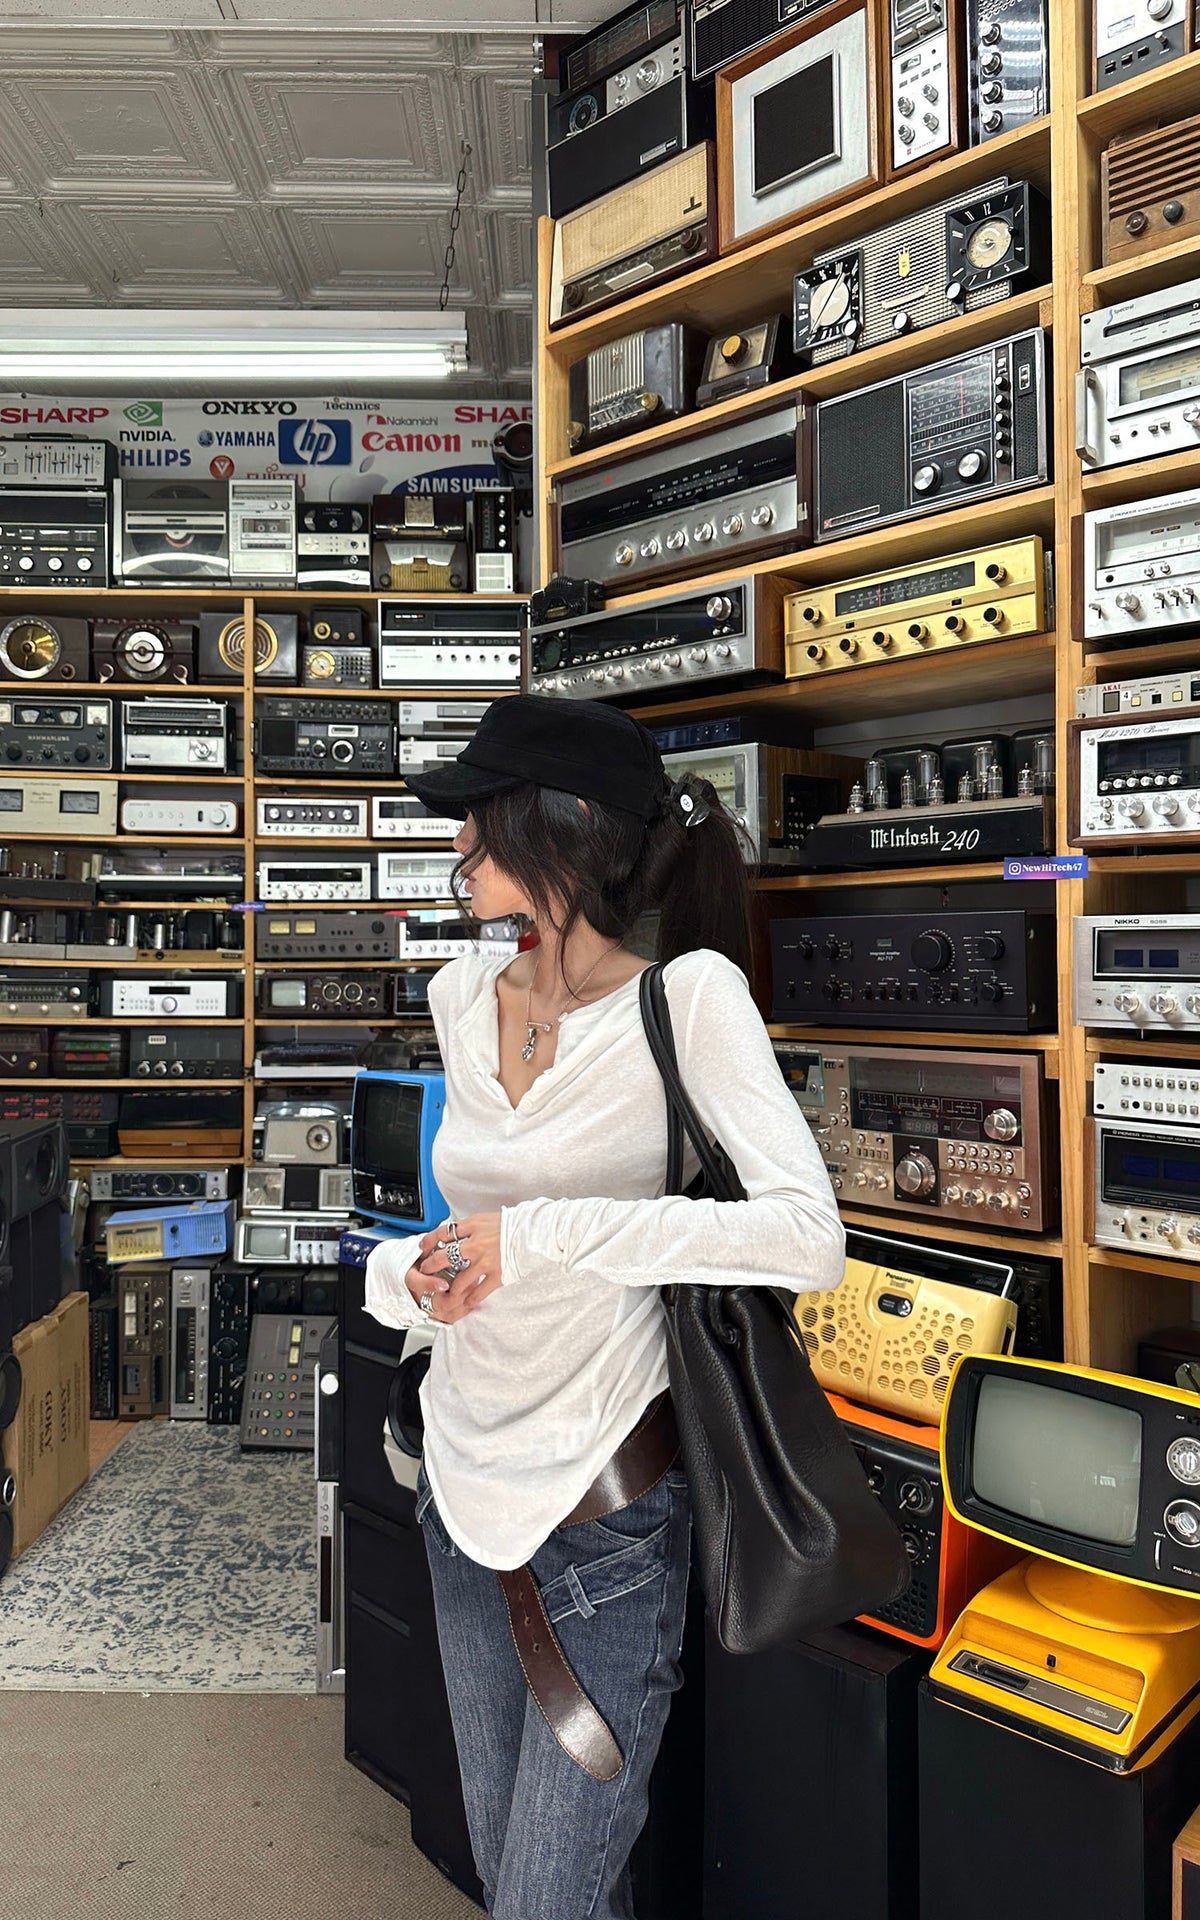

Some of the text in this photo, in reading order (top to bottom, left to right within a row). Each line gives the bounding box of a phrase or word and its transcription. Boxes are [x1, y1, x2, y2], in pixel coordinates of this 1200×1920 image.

[1113, 303, 1136, 315] Spectral
[202, 401, 298, 415] ONKYO
[323, 401, 381, 411] Technics
[0, 407, 109, 424] SHARP
[387, 416, 439, 426] Nakamichi
[455, 406, 532, 423] SHAR
[215, 431, 276, 447] YAMAHA
[299, 419, 332, 465] hp
[361, 431, 461, 452] Canon
[120, 449, 192, 467] HILIPS
[408, 477, 501, 493] SAMSUNG
[1115, 509, 1137, 518] PIONEER
[1102, 684, 1121, 692] AKAI
[1123, 691, 1129, 699] 4
[869, 824, 980, 852] McIntosh 240
[886, 1271, 914, 1284] Panasonic
[44, 1390, 53, 1449] GOKY
